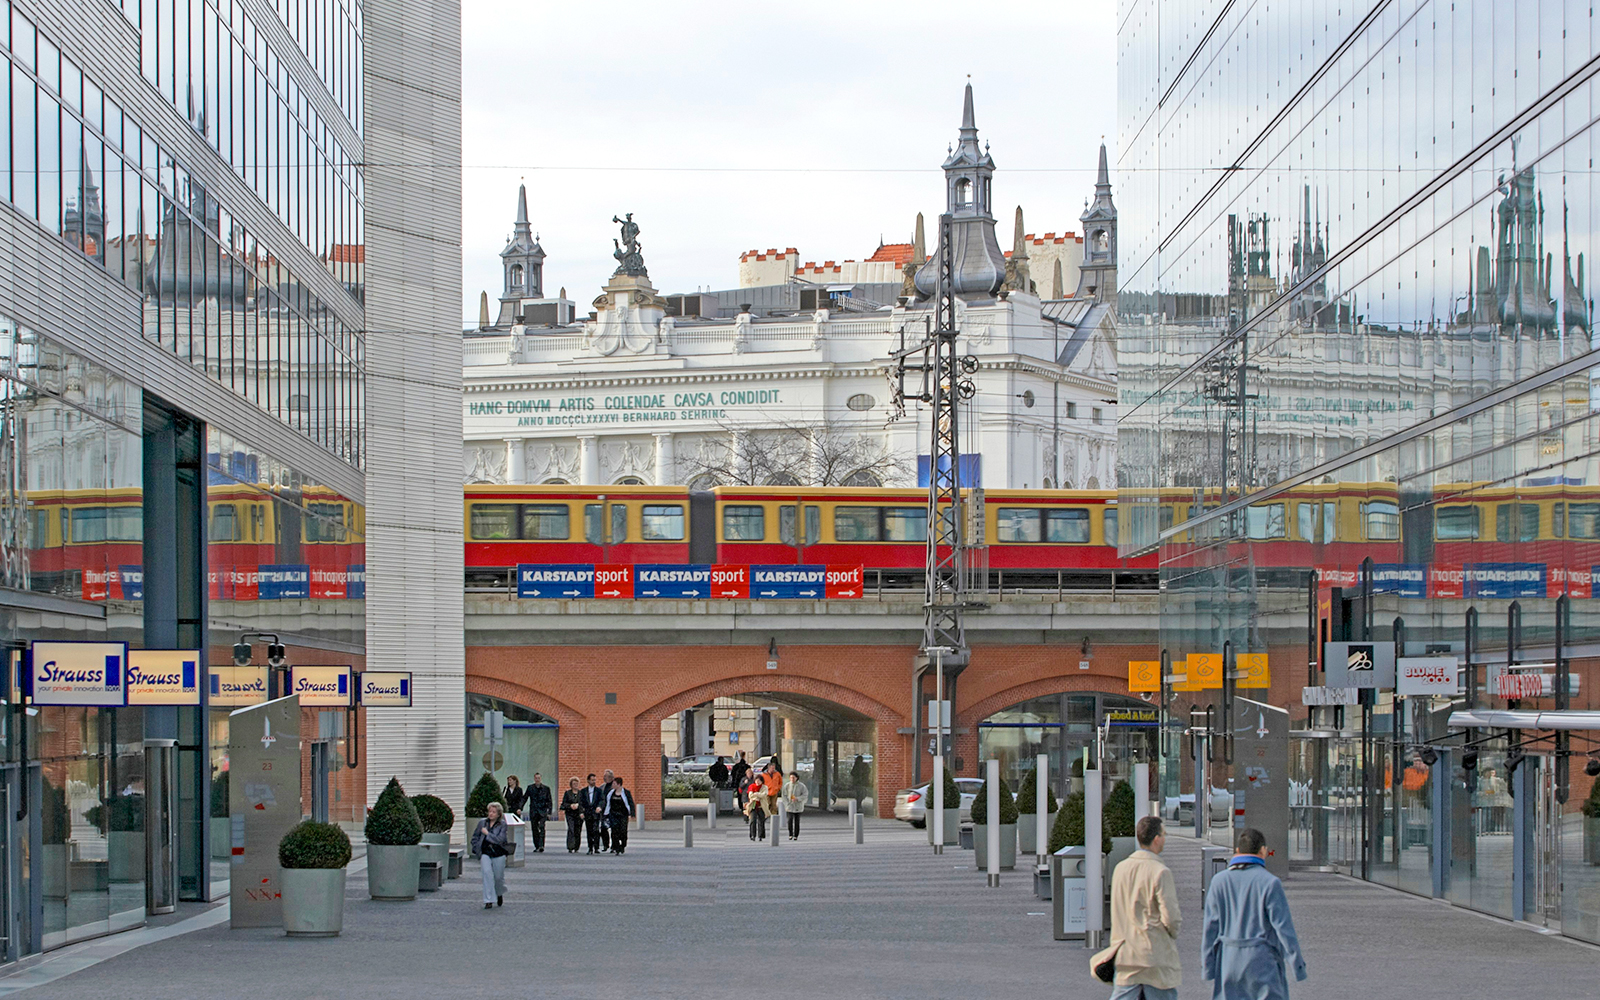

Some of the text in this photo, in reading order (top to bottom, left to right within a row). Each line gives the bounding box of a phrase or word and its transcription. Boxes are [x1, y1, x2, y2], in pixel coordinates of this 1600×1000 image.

[469, 389, 783, 416] HANC DOMVM ARTIS COLENDAE CAVSA CONDIDIT.
[517, 416, 544, 427] ANNO
[623, 411, 677, 422] BERNHARD
[523, 568, 629, 585] KARSTADT sport
[639, 568, 745, 586] KARSTADT sport
[755, 568, 859, 586] KARSTADT sport
[38, 661, 103, 682] Strauss
[128, 666, 181, 685] Strauss
[1404, 666, 1444, 678] BLUME
[295, 677, 337, 692] Strauss
[364, 682, 399, 694] Strauss
[1422, 676, 1452, 686] 2000
[37, 686, 51, 694] your
[52, 685, 73, 693] private
[262, 762, 273, 771] 23
